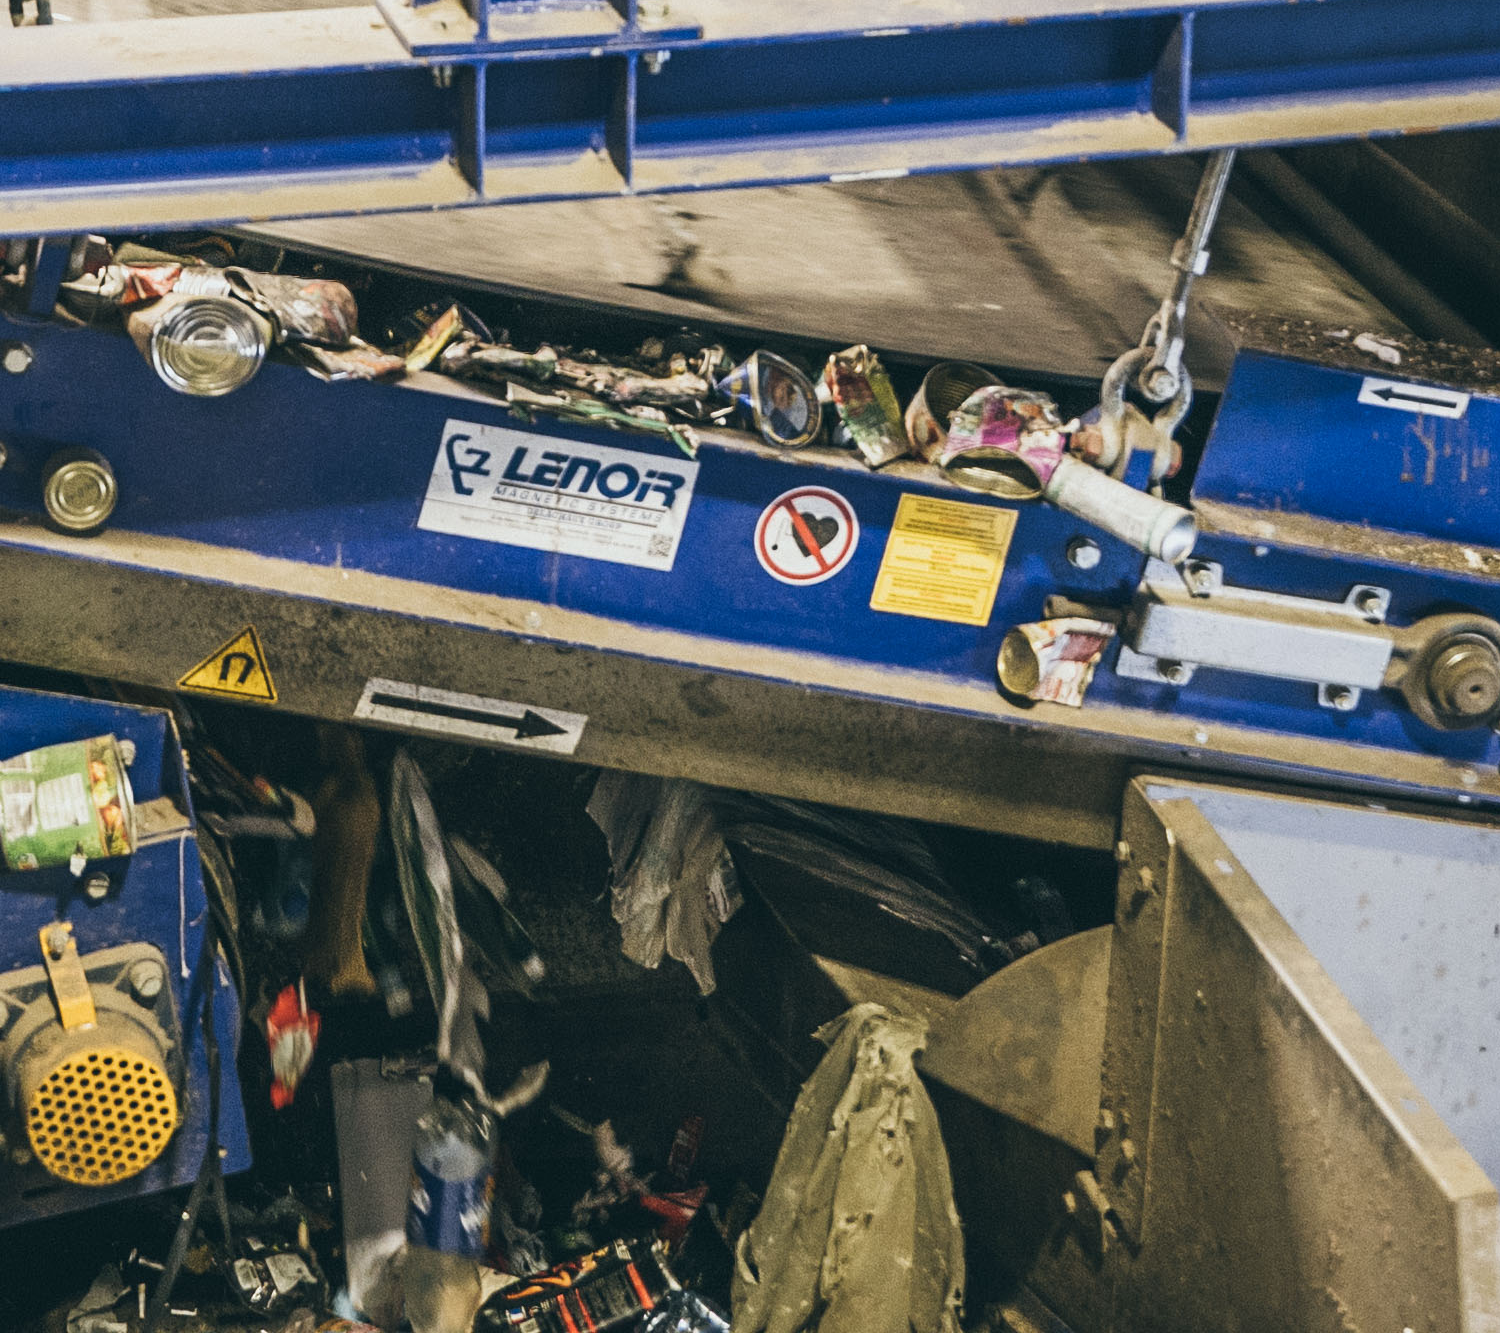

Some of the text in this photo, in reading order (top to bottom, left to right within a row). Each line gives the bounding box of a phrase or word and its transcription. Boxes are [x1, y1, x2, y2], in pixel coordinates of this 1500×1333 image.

[501, 446, 687, 509] LENOIR
[493, 485, 663, 523] MAGNETIC SYSTEMS
